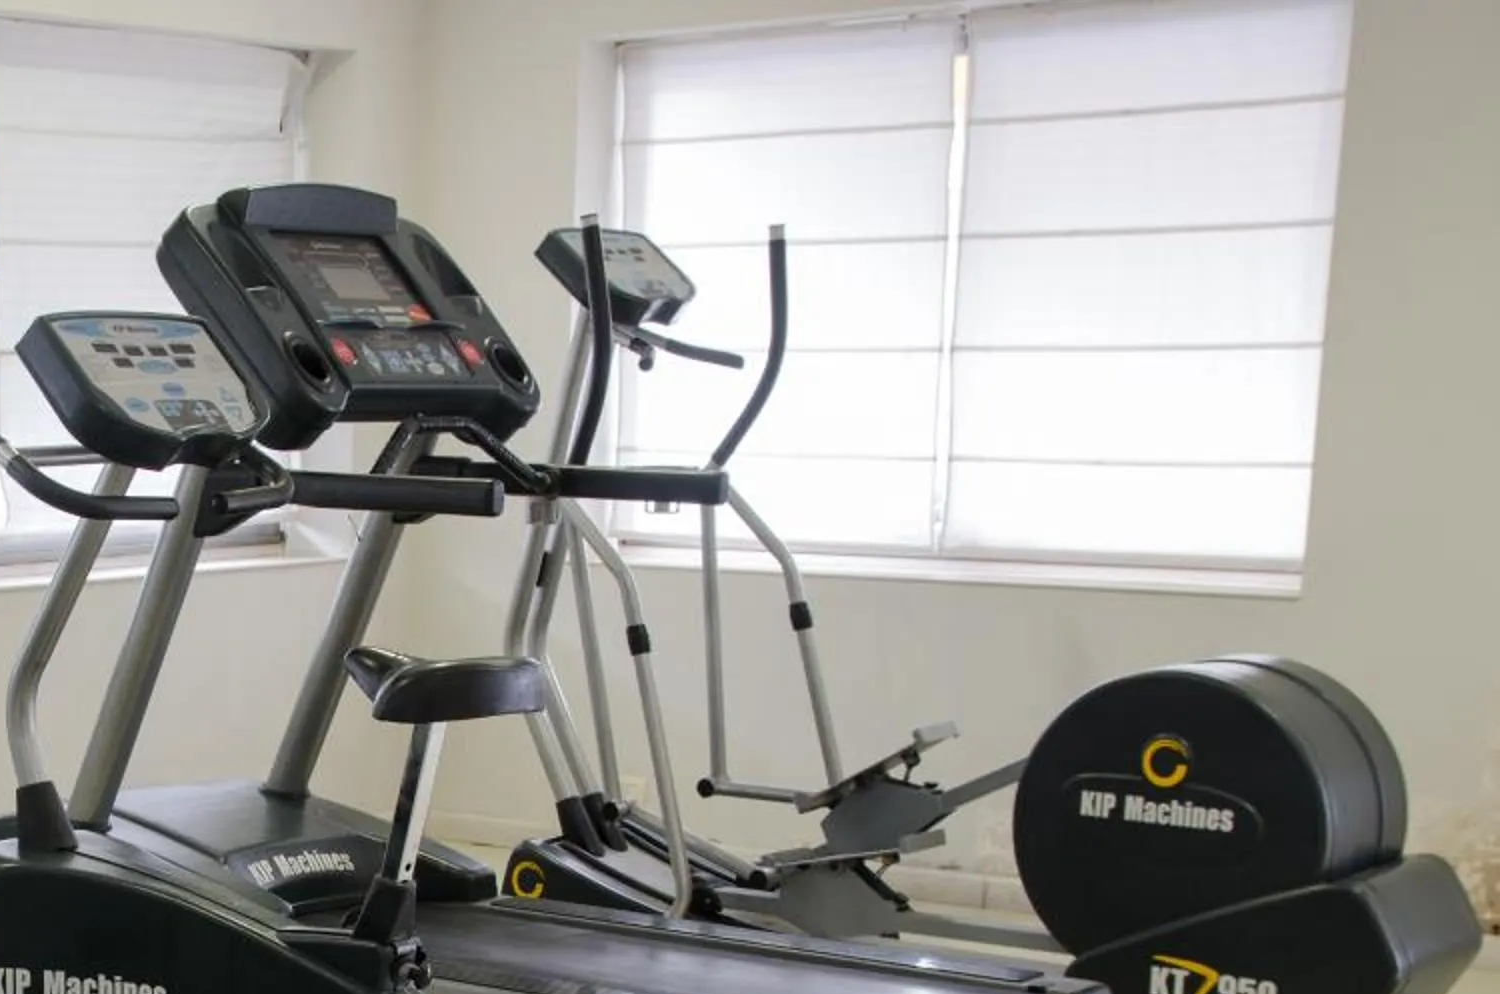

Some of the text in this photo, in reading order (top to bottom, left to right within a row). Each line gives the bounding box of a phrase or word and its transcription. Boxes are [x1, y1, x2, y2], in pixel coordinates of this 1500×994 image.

[1079, 790, 1236, 833] KIP Machines
[247, 849, 356, 887] KIP Machines
